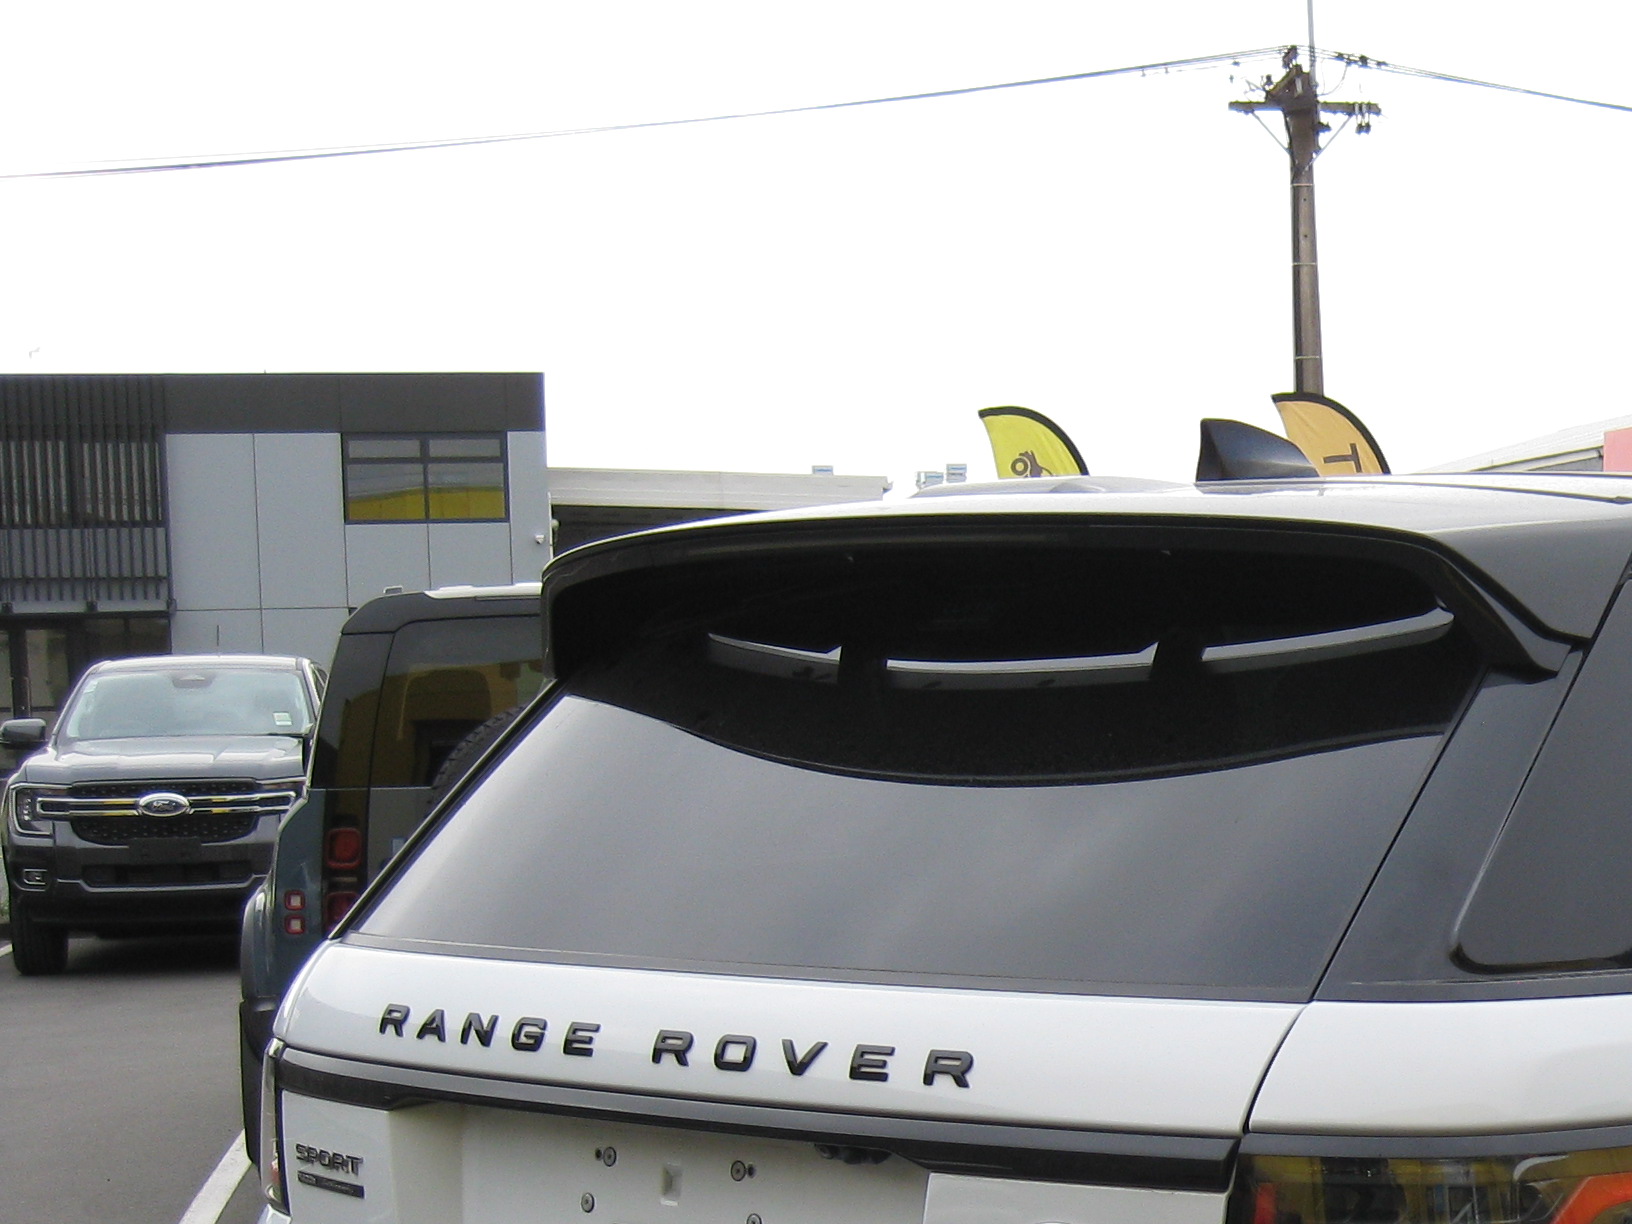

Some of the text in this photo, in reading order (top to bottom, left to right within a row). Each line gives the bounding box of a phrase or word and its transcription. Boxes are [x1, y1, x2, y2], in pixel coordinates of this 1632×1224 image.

[379, 1003, 974, 1088] RANGE ROVER
[295, 1143, 364, 1176] SPORT
